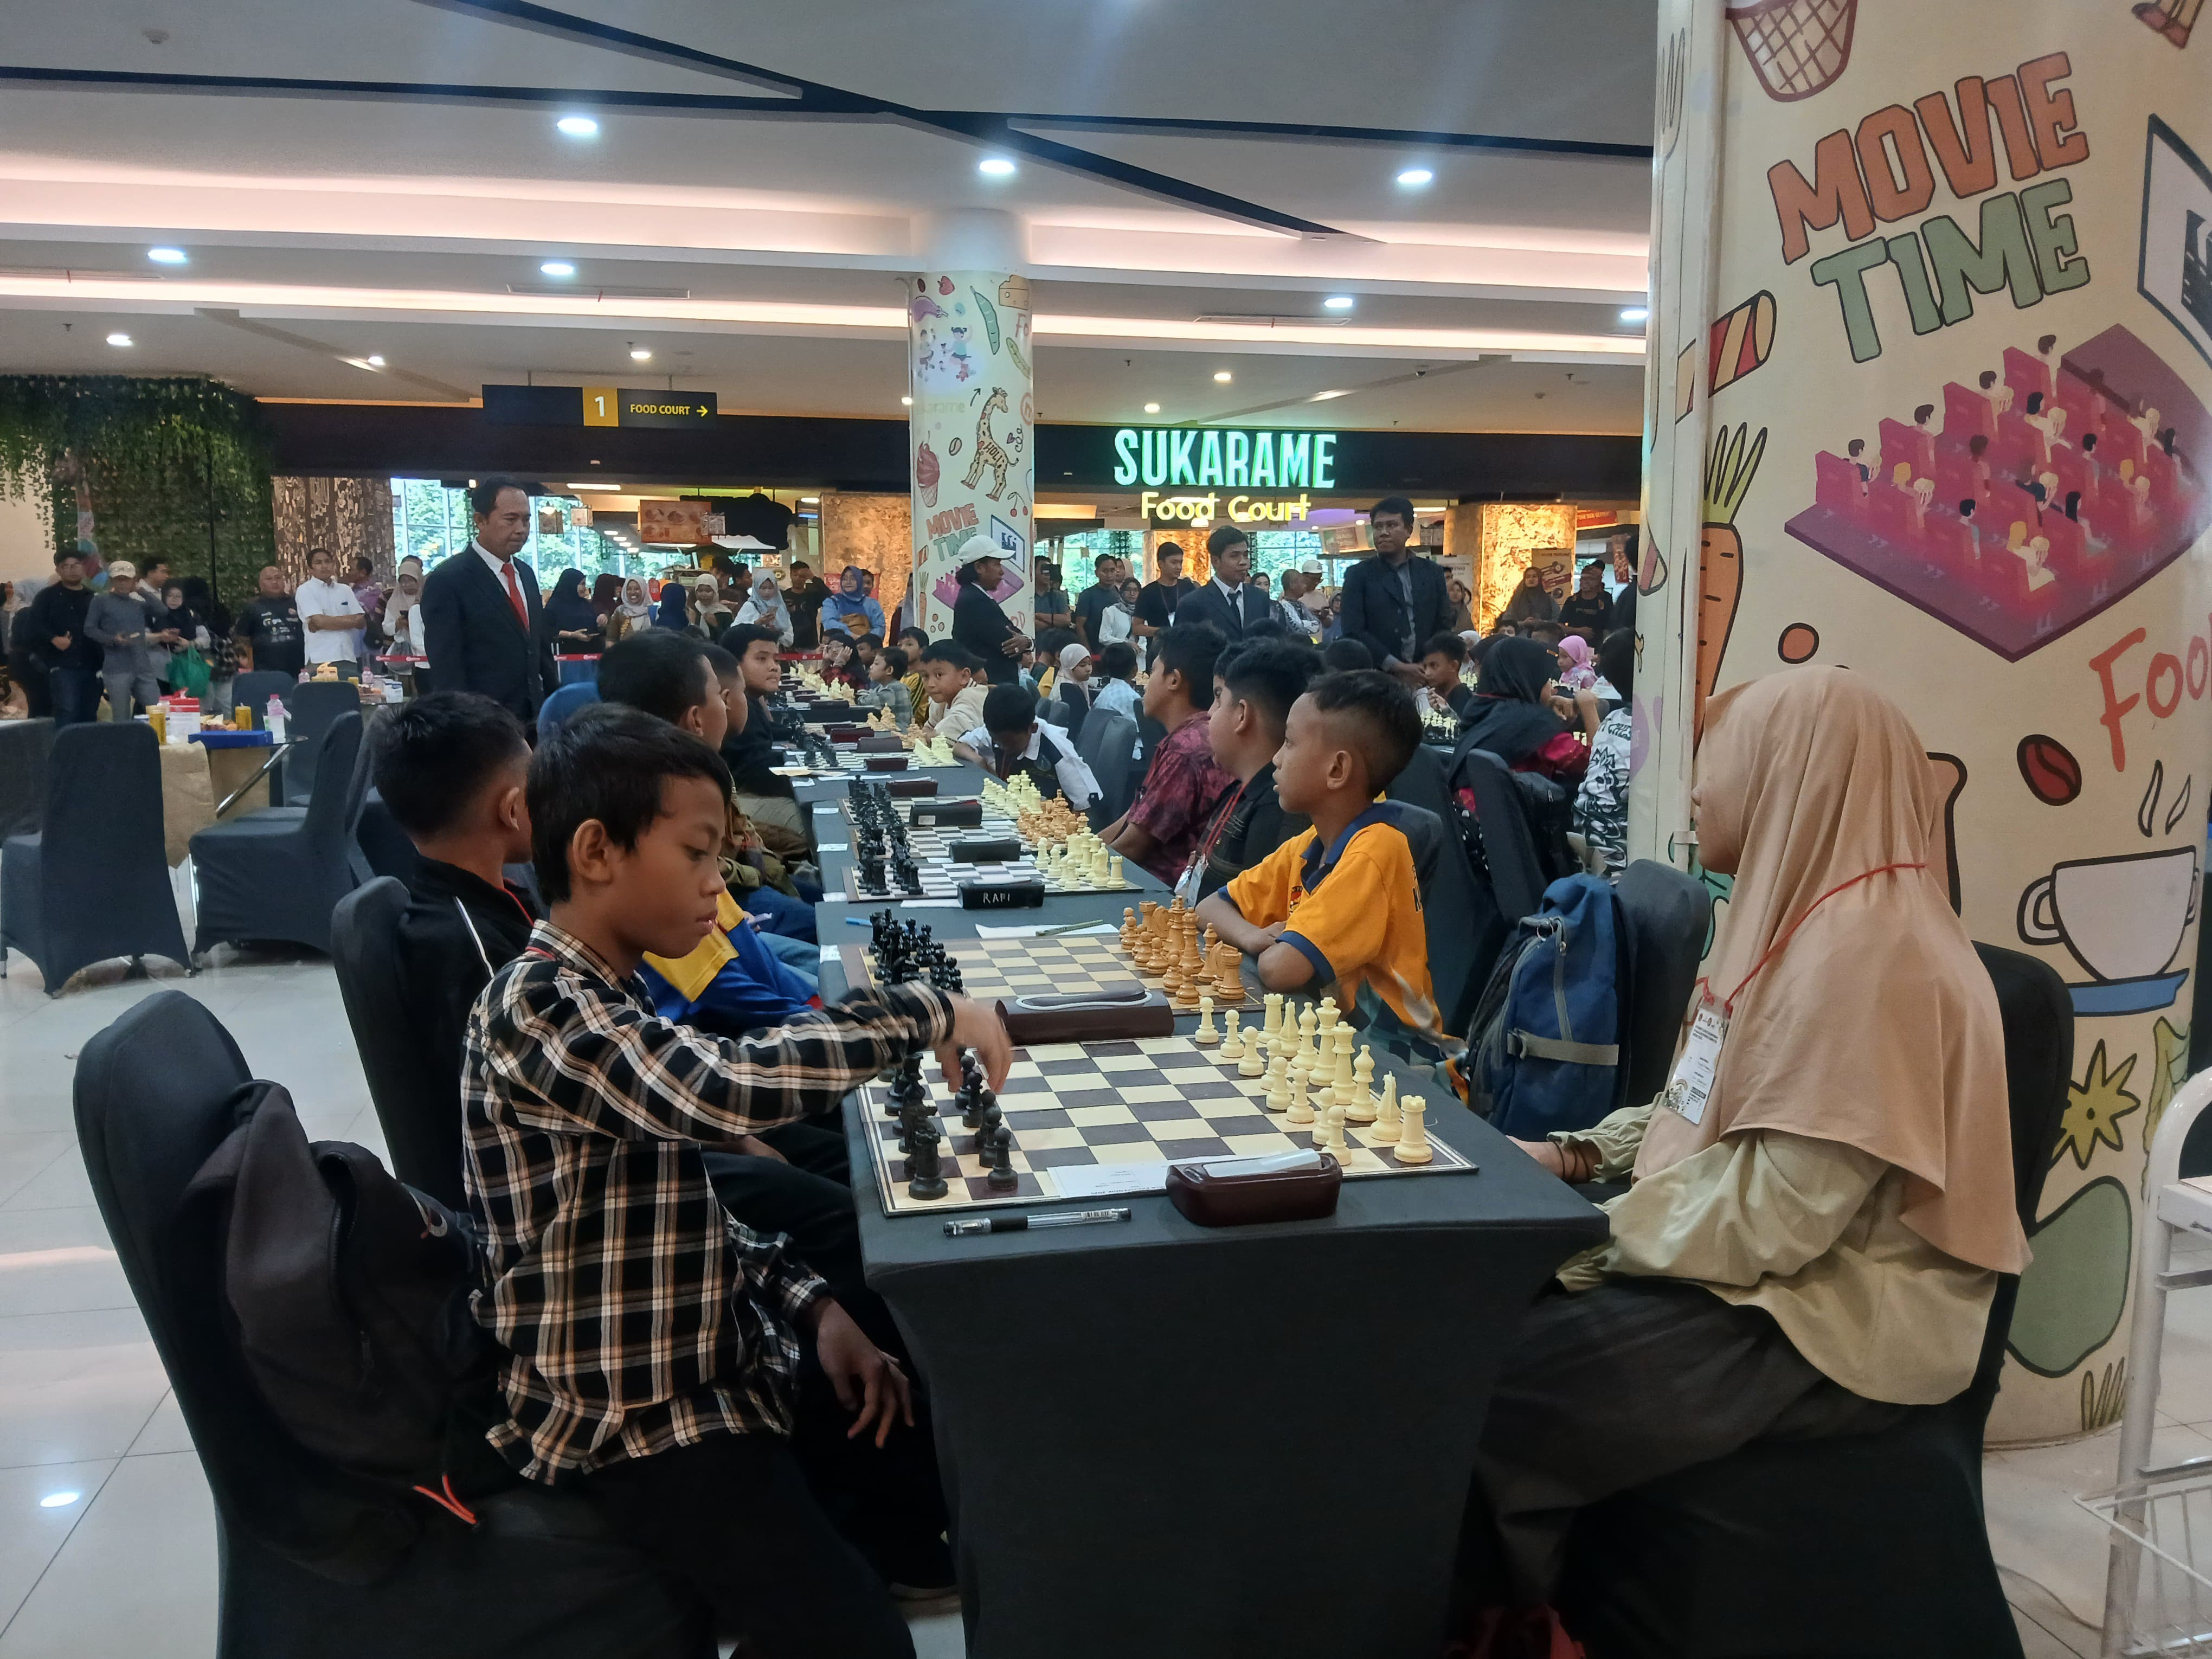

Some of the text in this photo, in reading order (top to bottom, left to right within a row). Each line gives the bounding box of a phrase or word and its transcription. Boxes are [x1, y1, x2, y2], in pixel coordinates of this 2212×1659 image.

[1767, 52, 2089, 266] MOVIE
[1810, 178, 2091, 363] TIME
[594, 396, 605, 417] 1
[630, 404, 690, 415] FOOD COURT
[1114, 429, 1337, 488] SUKARAME
[926, 503, 979, 541] MOVIE
[1141, 491, 1311, 522] Food Court
[2088, 612, 2212, 773] Foo
